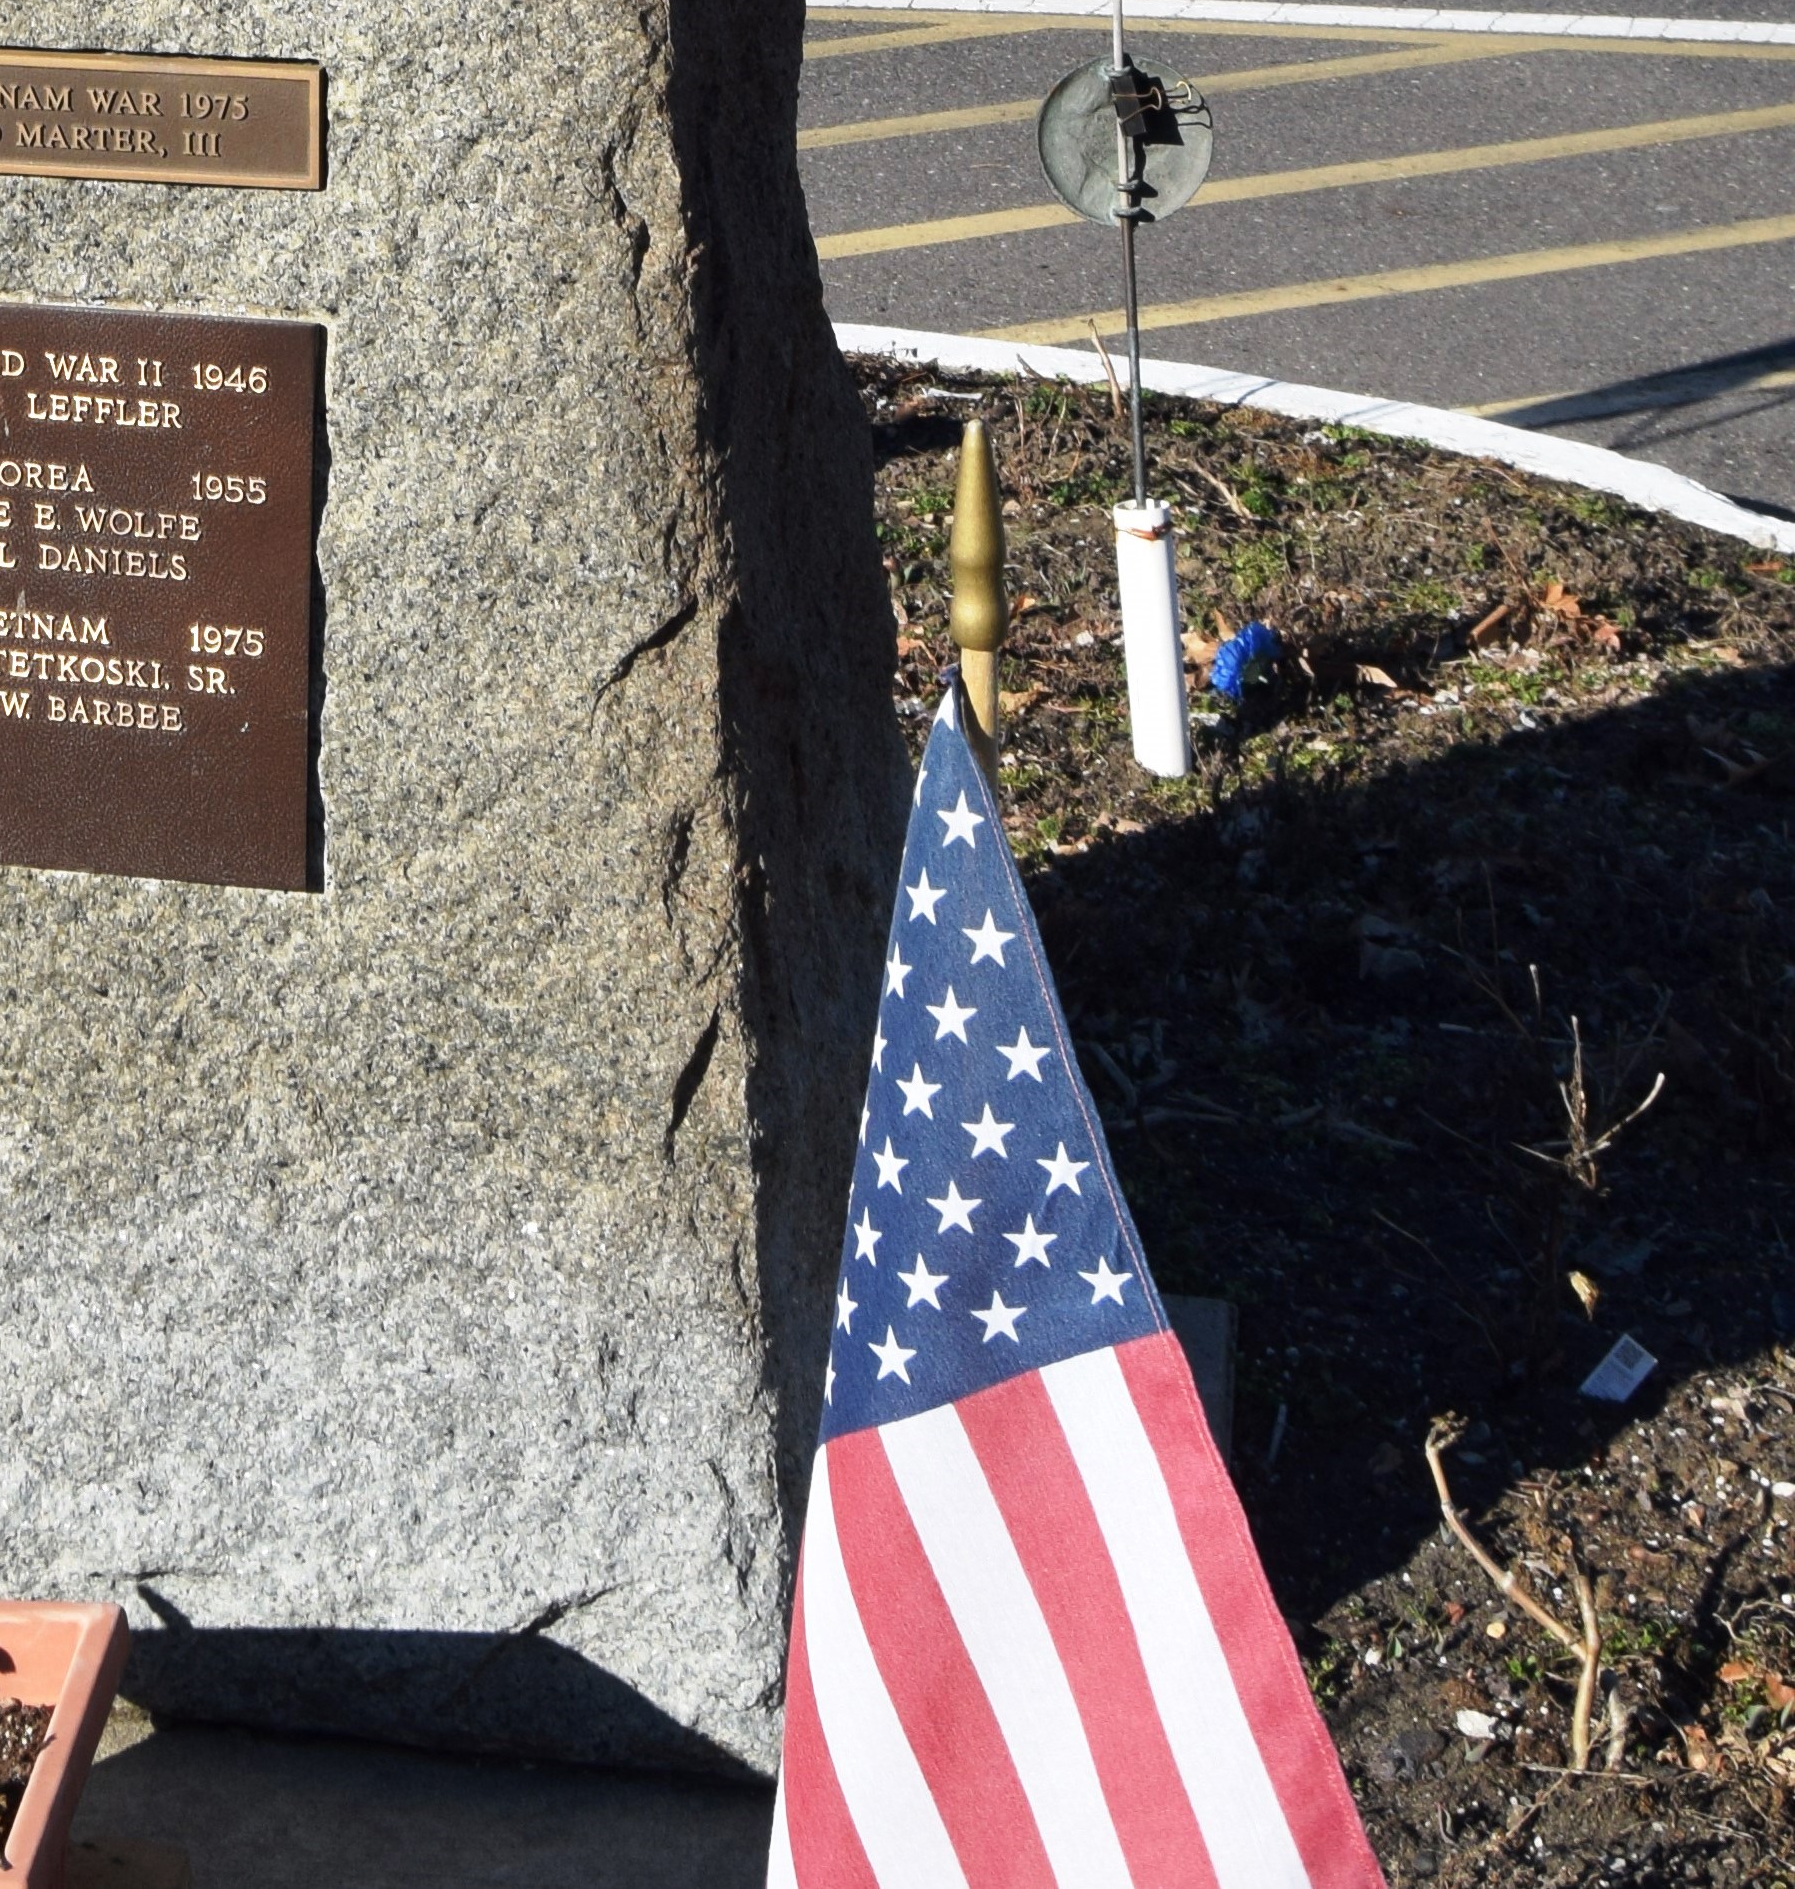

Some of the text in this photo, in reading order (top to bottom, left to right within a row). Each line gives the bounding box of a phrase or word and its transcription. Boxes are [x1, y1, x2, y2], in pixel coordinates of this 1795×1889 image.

[86, 89, 163, 117] WAR
[180, 92, 249, 120] 1975
[16, 121, 167, 158] MARTER,
[183, 132, 221, 158] III
[46, 352, 120, 383] WAR
[138, 359, 163, 388] II
[192, 364, 268, 394] 1946
[28, 393, 182, 428] LEFFLER
[192, 472, 267, 504] 1955
[35, 501, 61, 530] E.
[76, 507, 202, 542] WOLFE
[39, 545, 189, 581] DANIELS
[189, 625, 264, 657] 1975
[188, 665, 236, 695] SR.
[49, 696, 185, 731] BARBEE
